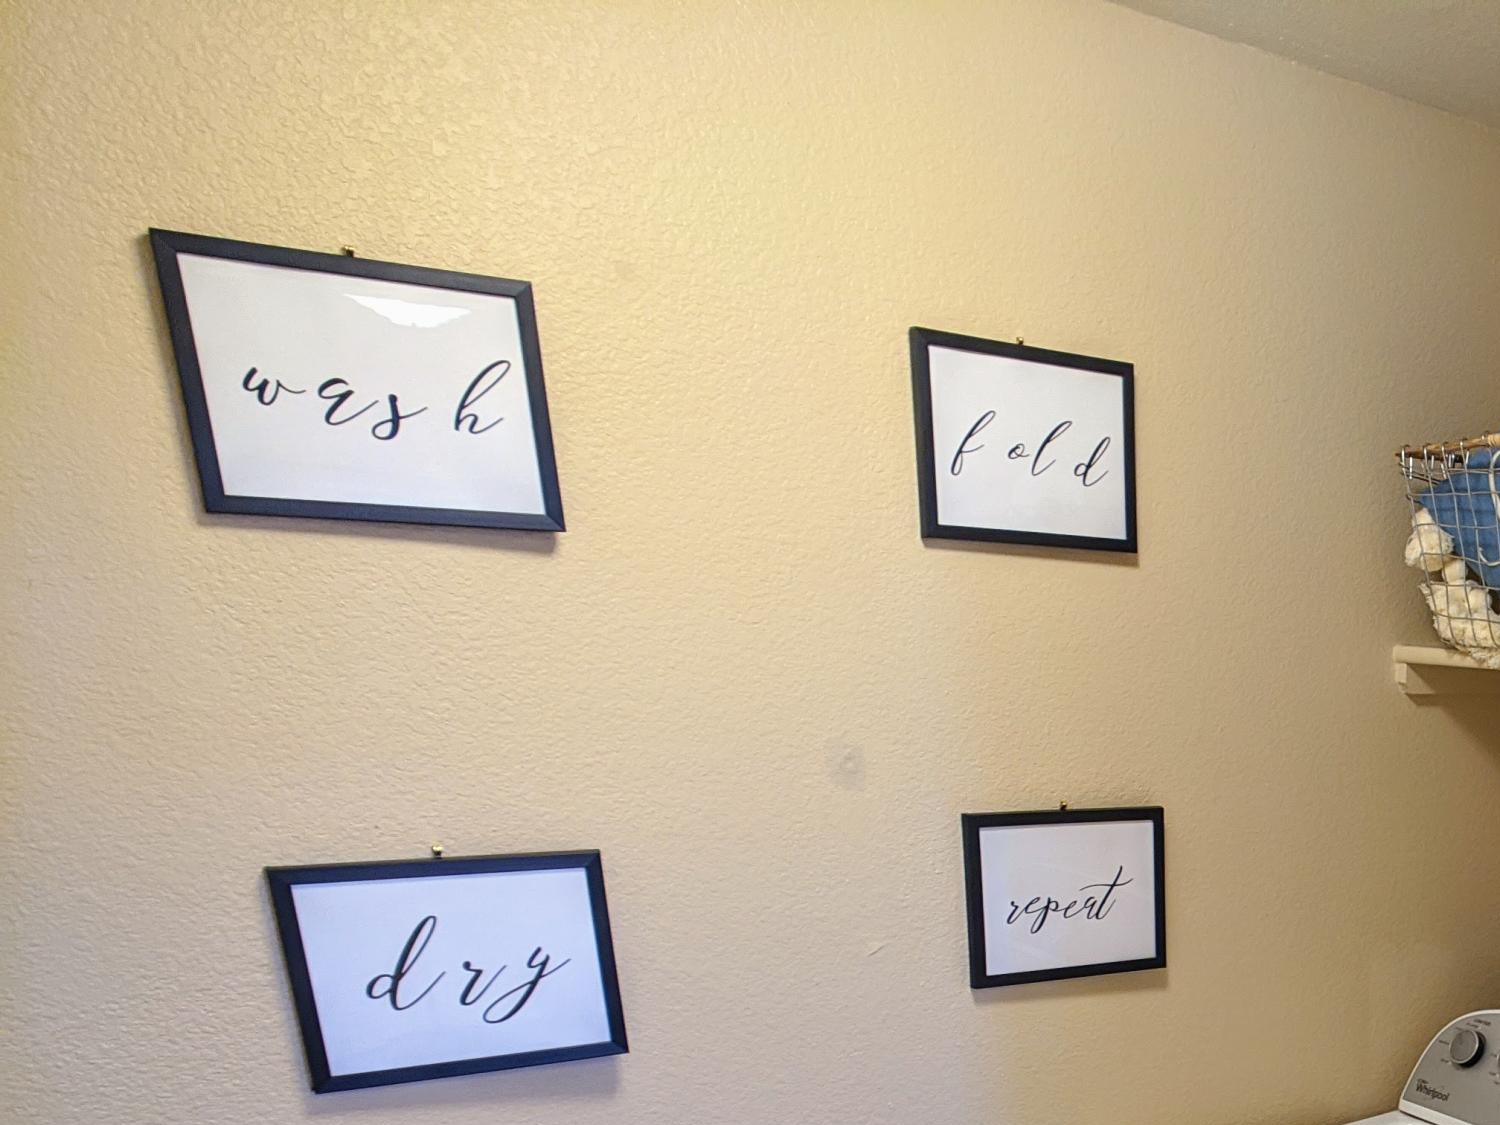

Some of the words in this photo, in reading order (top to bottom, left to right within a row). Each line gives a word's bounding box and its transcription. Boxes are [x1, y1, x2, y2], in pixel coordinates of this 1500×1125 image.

[242, 360, 511, 440] wash
[951, 410, 1111, 487] fold
[1006, 865, 1134, 934] repeat
[366, 915, 572, 1024] dry
[1415, 1081, 1451, 1102] Whirlpool
